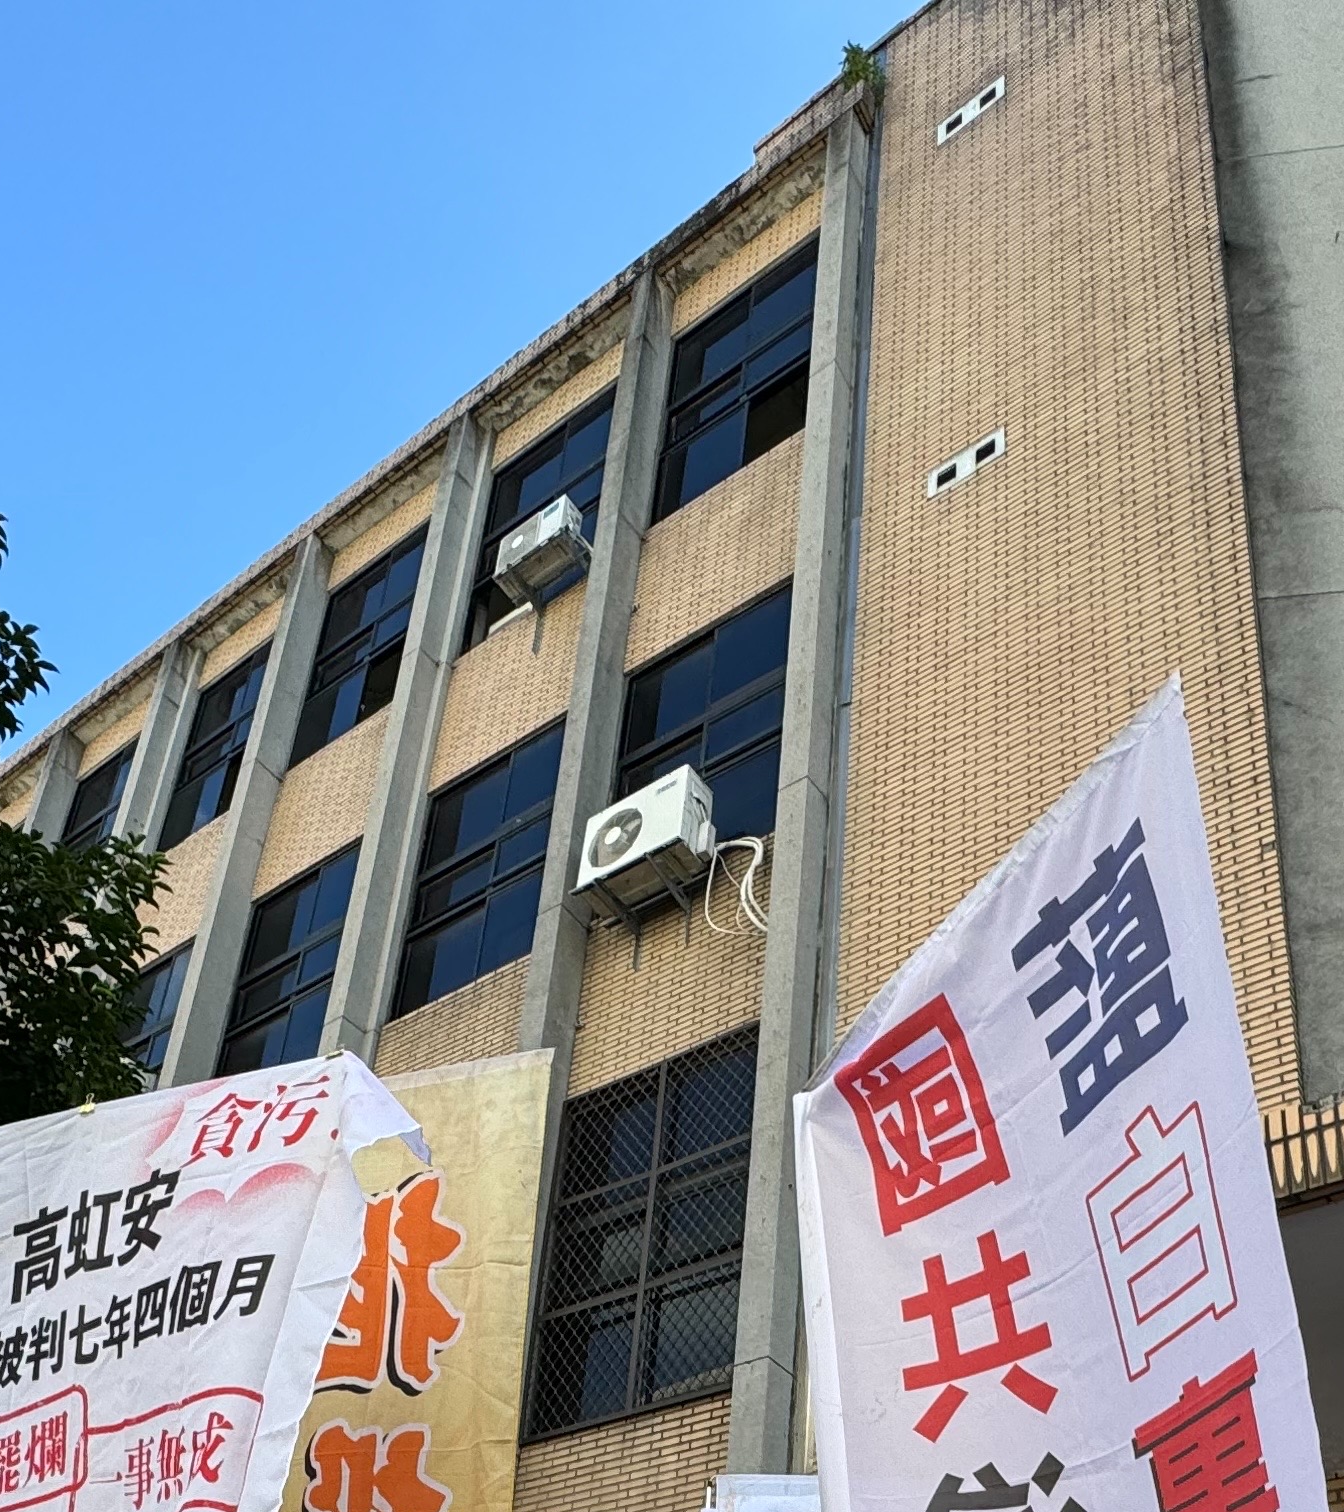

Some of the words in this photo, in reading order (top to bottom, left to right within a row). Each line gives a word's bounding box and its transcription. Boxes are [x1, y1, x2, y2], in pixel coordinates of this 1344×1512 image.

[11, 1169, 180, 1304] 高虹安
[88, 1411, 234, 1510] 一事無成
